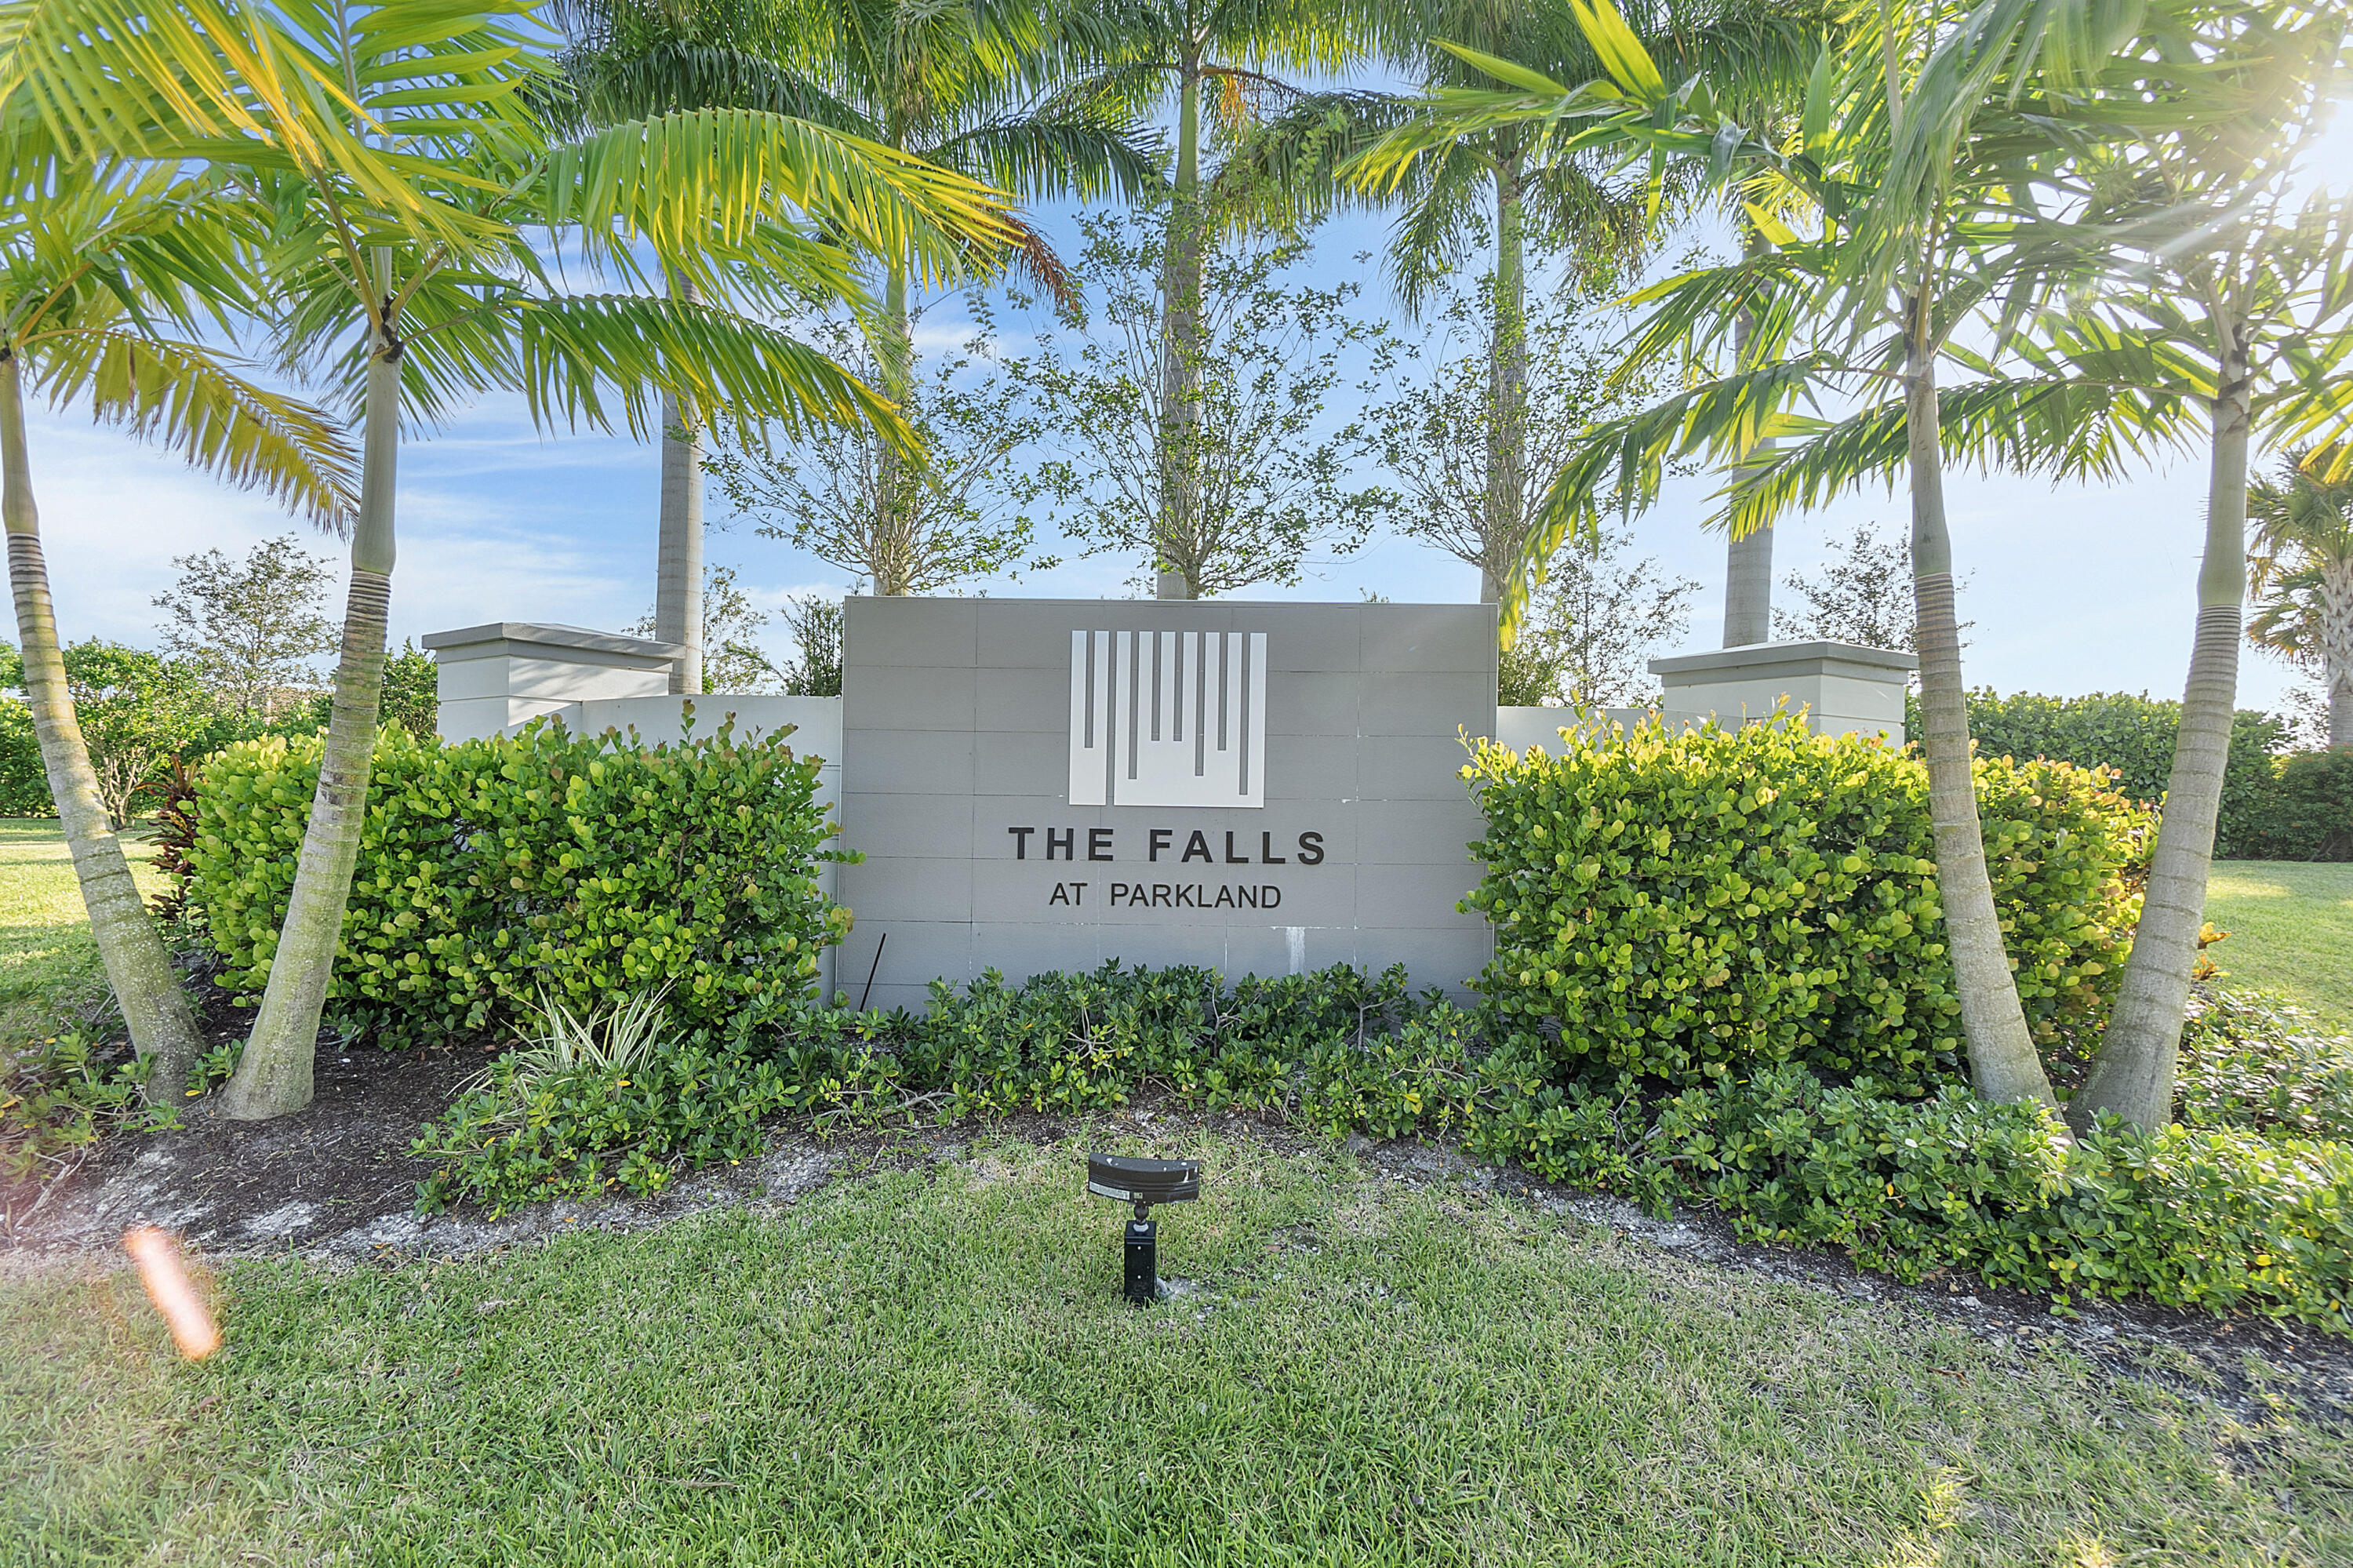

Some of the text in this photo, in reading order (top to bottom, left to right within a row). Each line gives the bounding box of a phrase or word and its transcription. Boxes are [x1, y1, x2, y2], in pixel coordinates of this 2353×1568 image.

[1008, 827, 1325, 866] THE FALLS
[1049, 882, 1282, 908] AT PARKLAND
